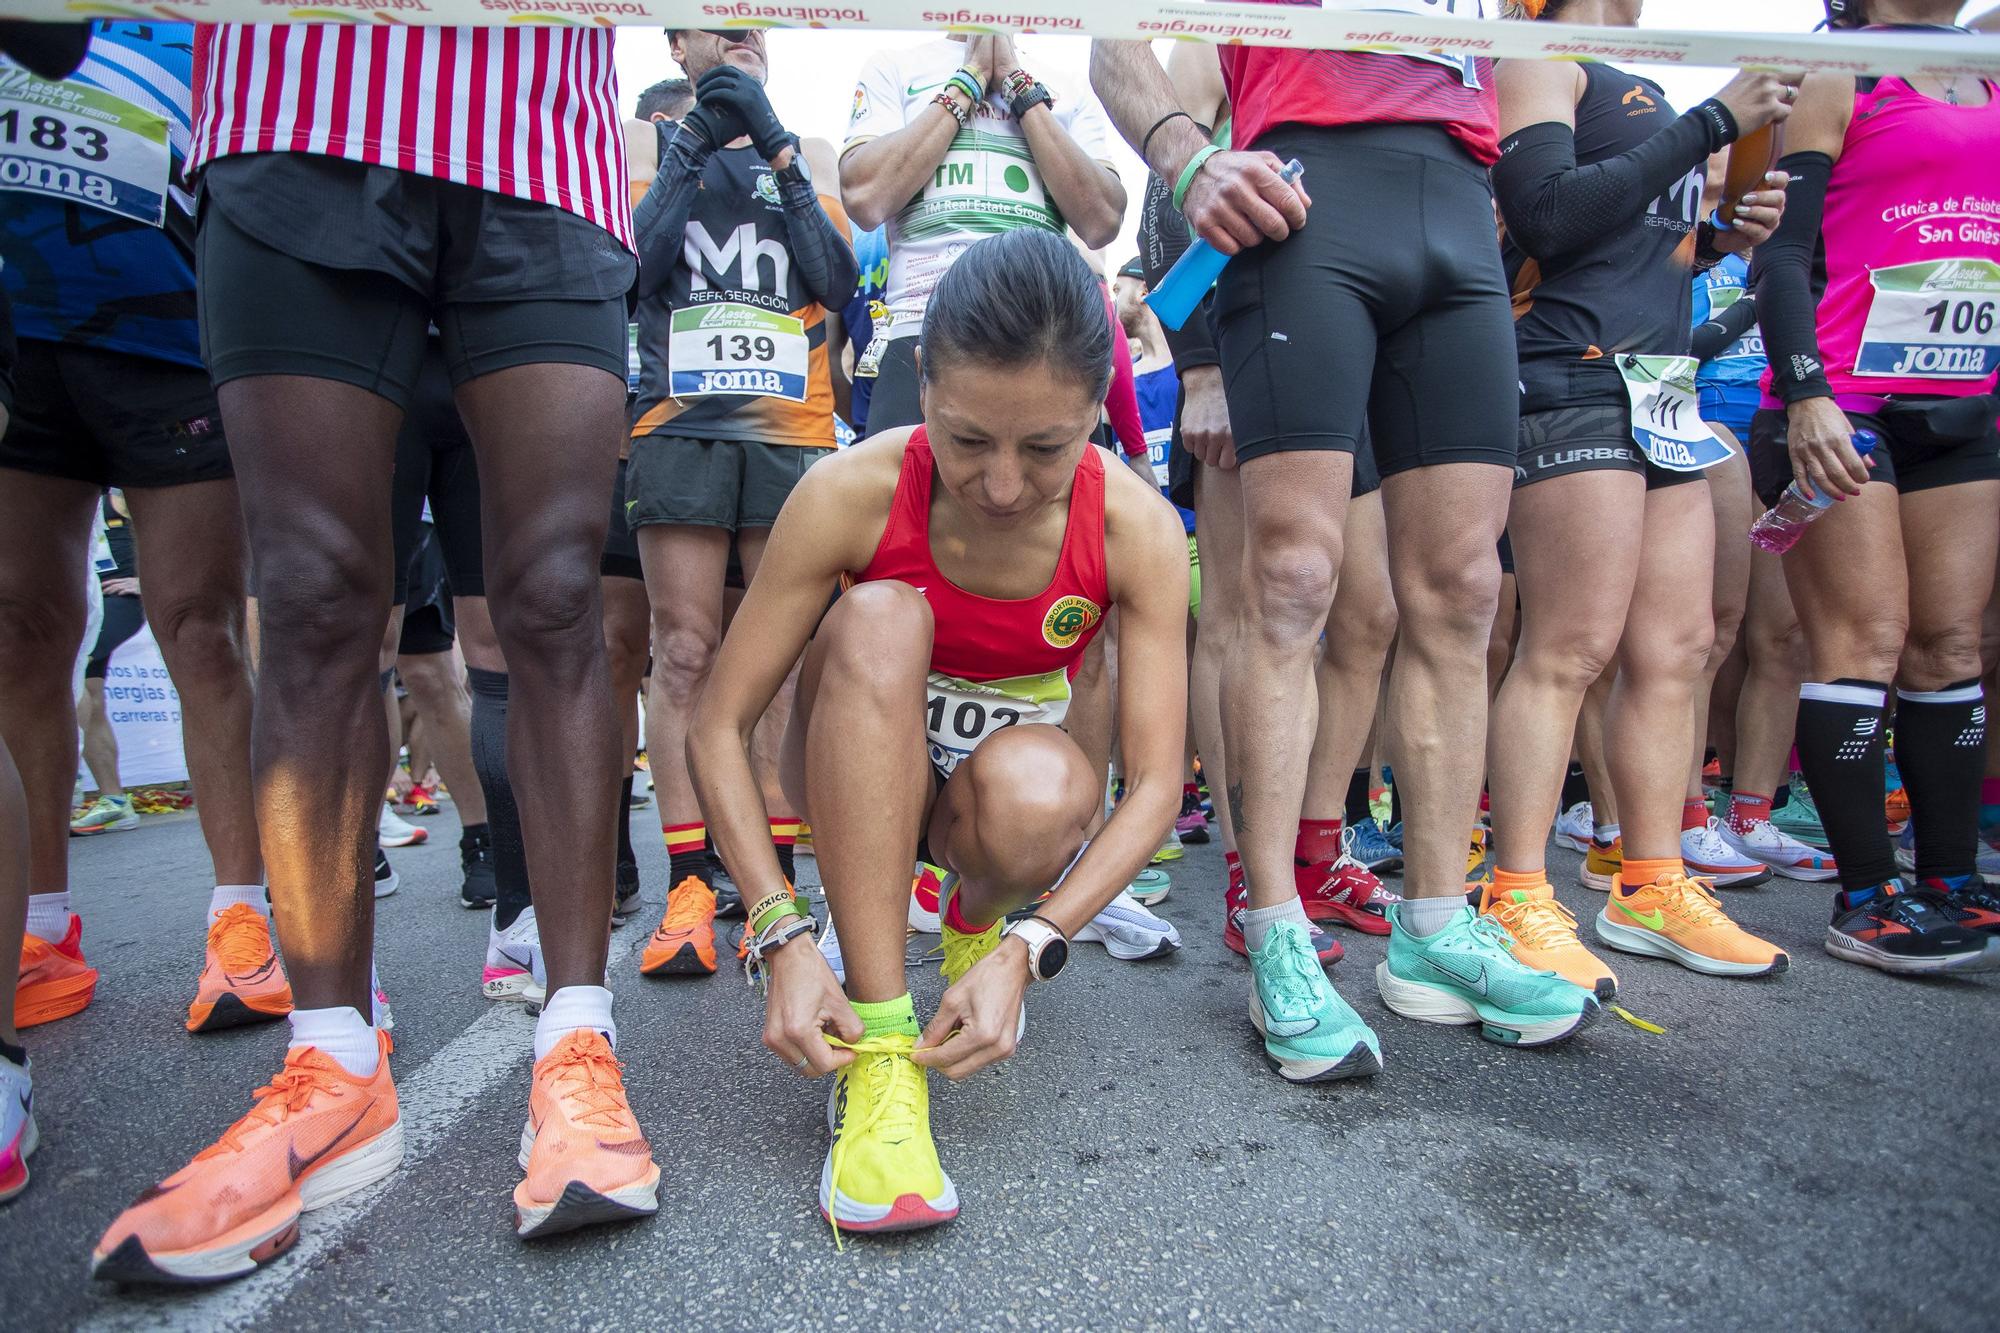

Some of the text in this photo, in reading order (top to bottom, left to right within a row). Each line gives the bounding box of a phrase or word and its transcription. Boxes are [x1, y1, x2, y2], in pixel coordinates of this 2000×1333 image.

[480, 0, 652, 16] TotalEnergies
[702, 2, 870, 22] TotalEnergies
[922, 9, 1085, 30] TotalEnergies
[1136, 20, 1293, 41] TotalEnergies
[1343, 30, 1495, 50] TotalEnergies
[1541, 41, 1688, 62] TotalEnergies
[0, 109, 109, 162] 183
[0, 157, 118, 206] oma
[935, 163, 973, 188] TM
[924, 198, 1048, 224] TM Real Estate Group
[1882, 200, 1939, 223] Clínica
[1943, 197, 1959, 212] de
[1918, 223, 2000, 246] San Ginés
[684, 221, 789, 298] Mh
[689, 290, 790, 312] REFRGERACIÓN
[1924, 299, 1995, 335] 106
[707, 334, 775, 362] 139
[1738, 337, 1766, 356] Jo
[1790, 354, 1806, 381] adidas
[1650, 391, 1683, 431] 111
[1046, 599, 1073, 628] ESPORTIU
[134, 664, 149, 679] la
[112, 711, 169, 723] carreras
[927, 695, 1021, 739] 102
